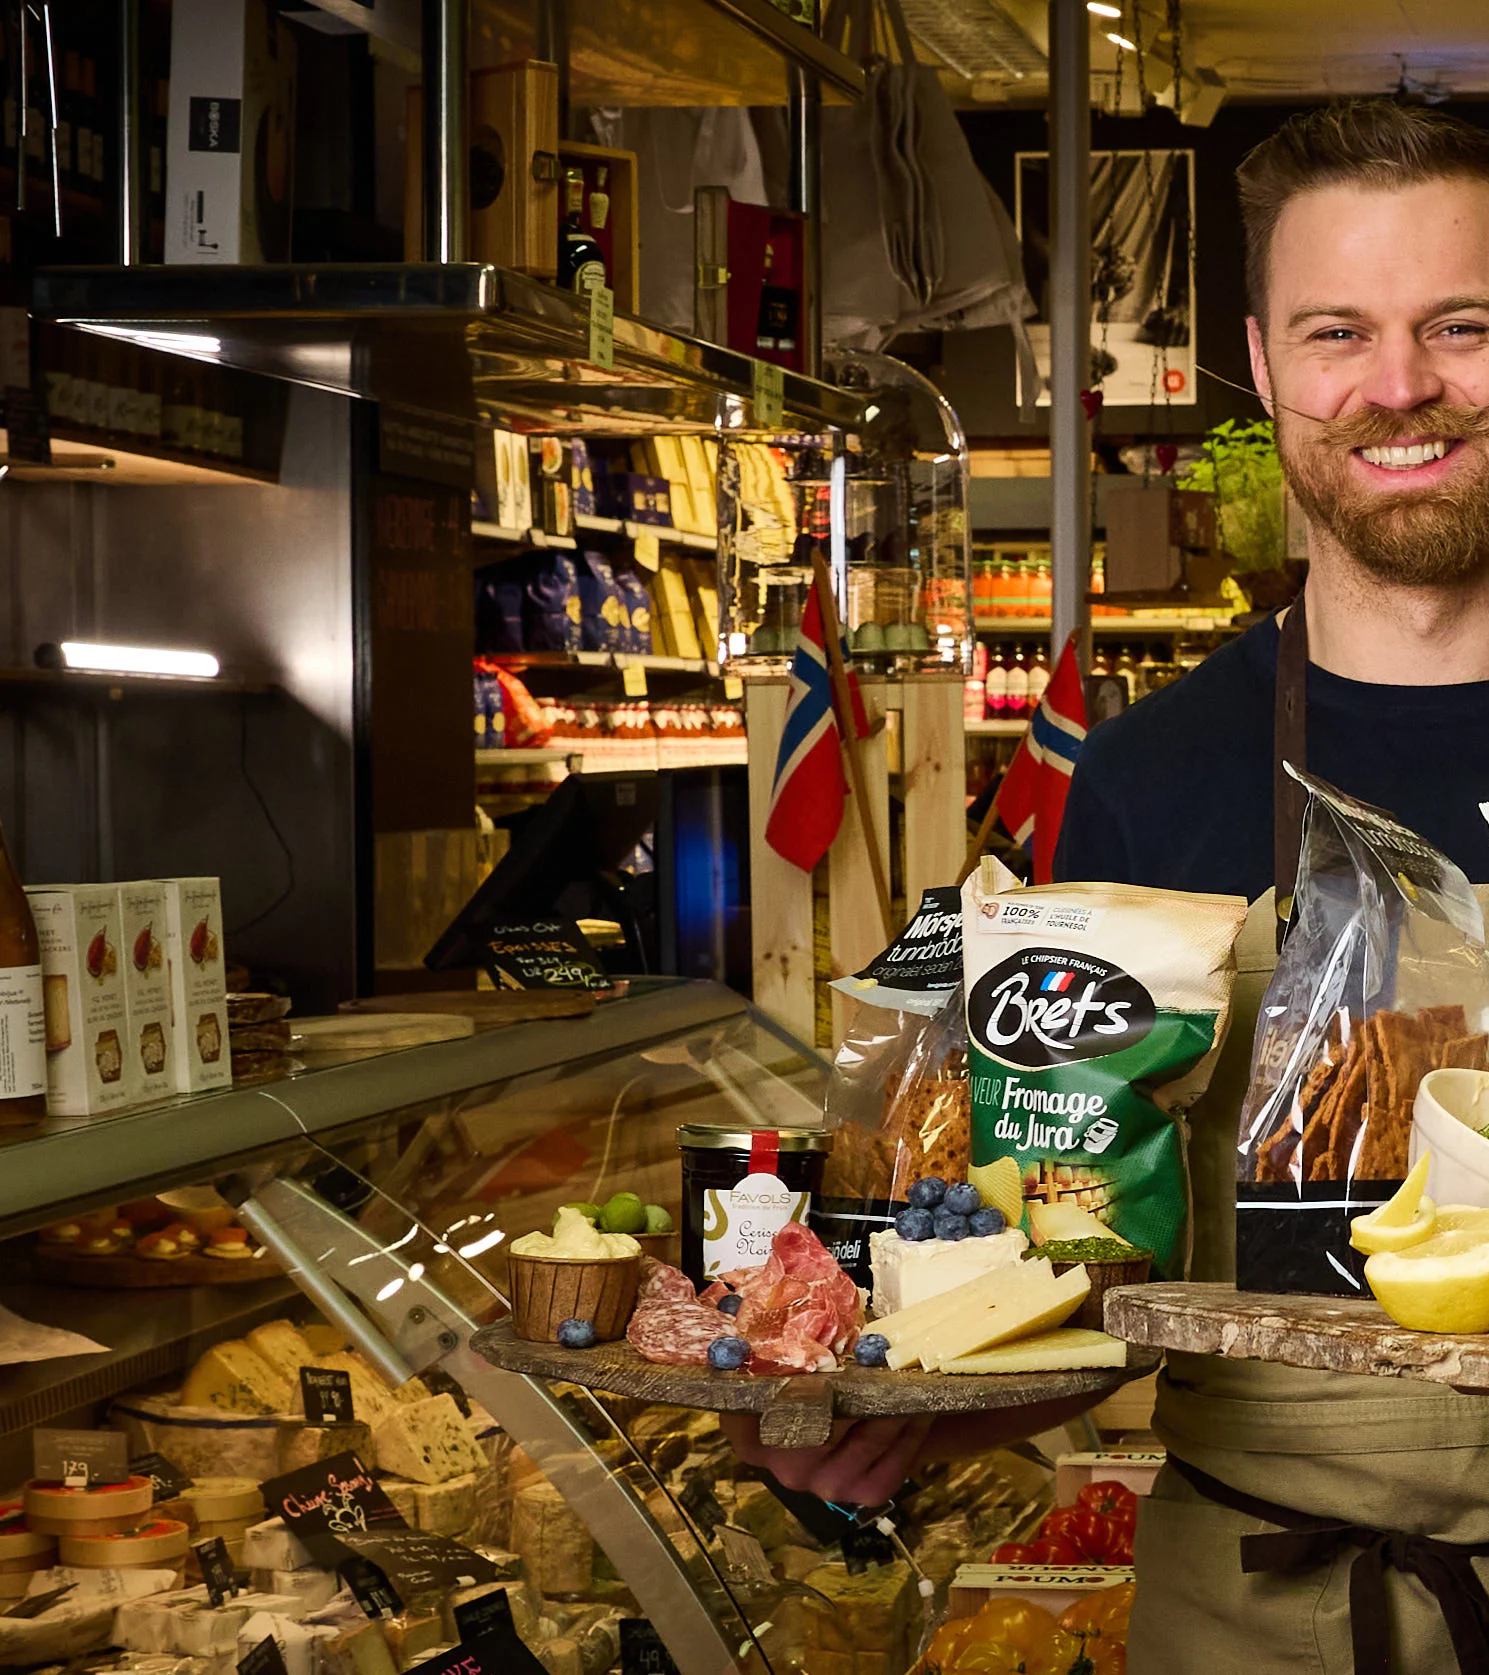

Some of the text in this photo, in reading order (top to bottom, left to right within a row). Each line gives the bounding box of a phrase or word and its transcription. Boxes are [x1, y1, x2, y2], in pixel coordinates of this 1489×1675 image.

[1002, 906, 1040, 920] 100%
[1046, 920, 1088, 932] TOURNESOL
[1021, 954, 1108, 977] LE CHIPSIER FRANÇAIS
[970, 1076, 1107, 1124] VEUR Fromage
[994, 1113, 1080, 1151] du Jura
[730, 1191, 791, 1204] FAVOLS
